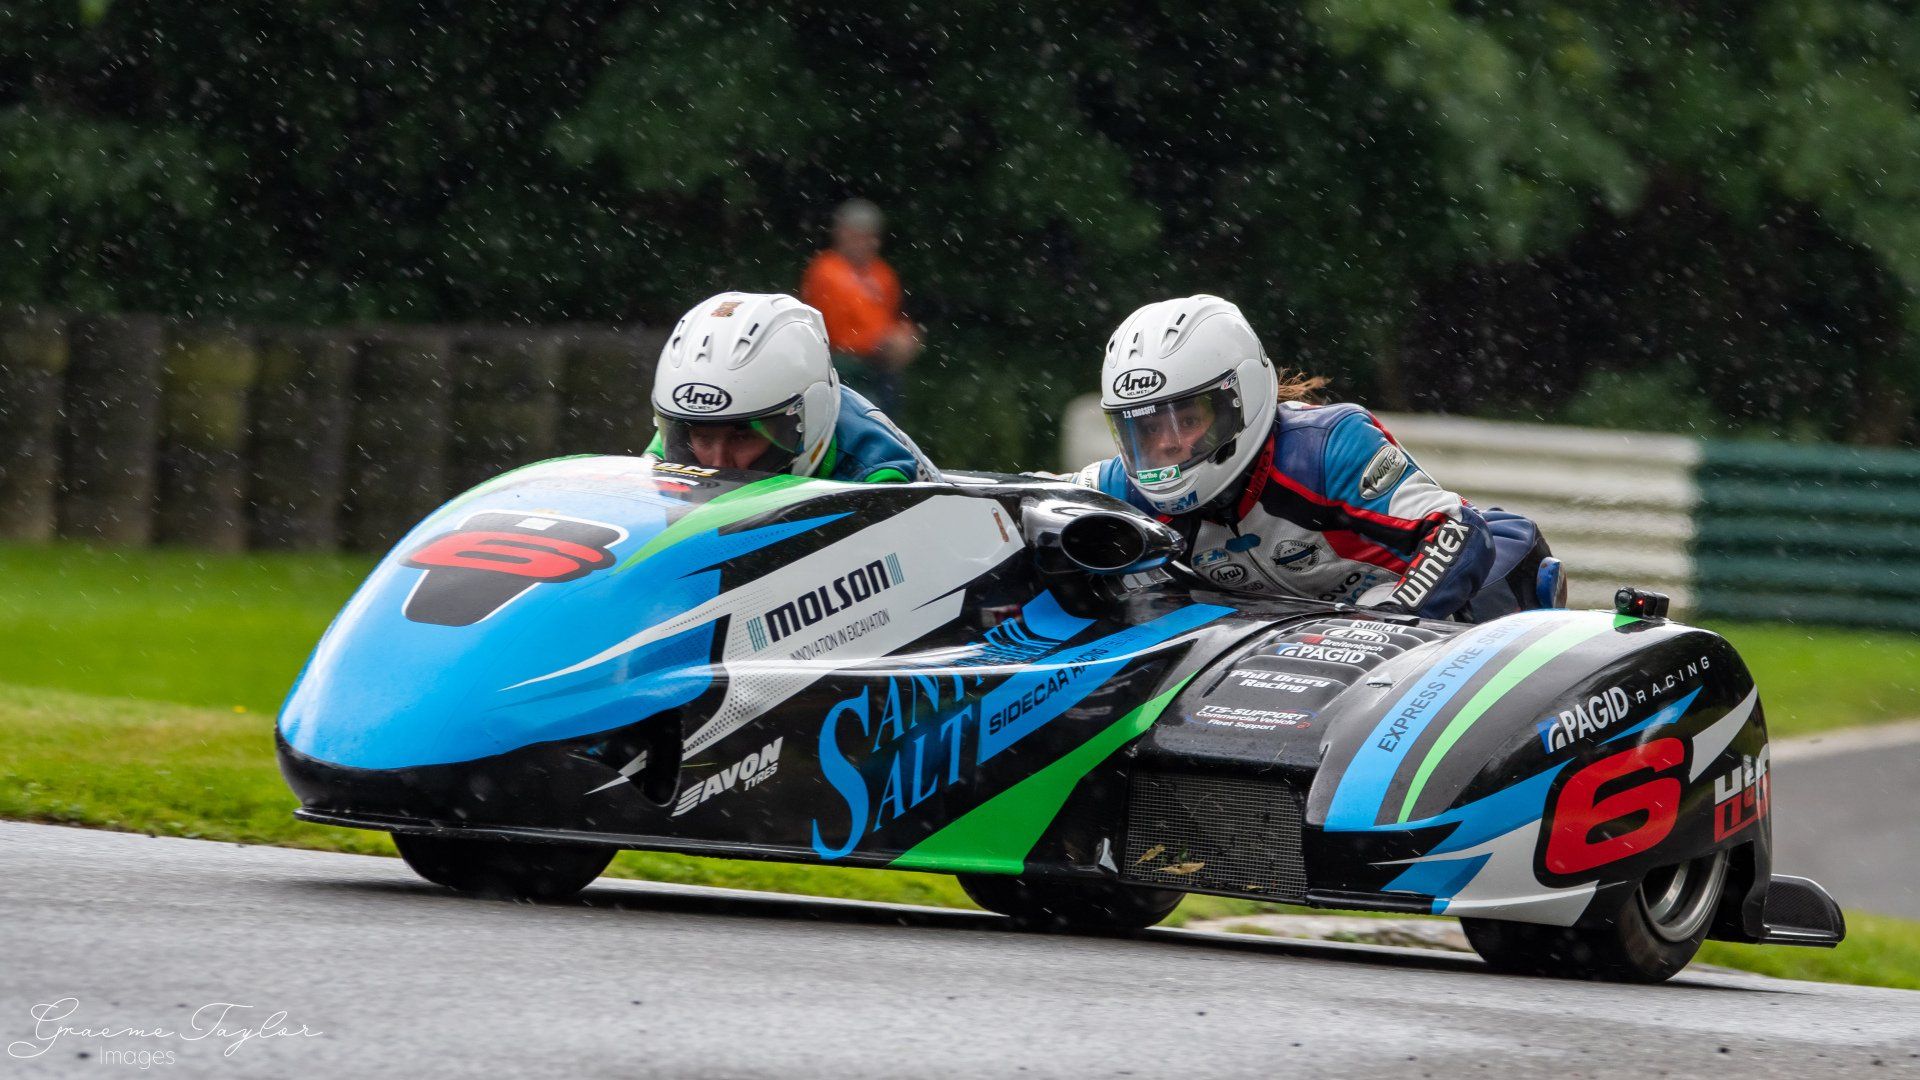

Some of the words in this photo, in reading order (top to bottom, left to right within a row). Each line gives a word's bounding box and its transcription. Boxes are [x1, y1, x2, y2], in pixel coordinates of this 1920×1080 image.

[1116, 371, 1159, 394] Arai
[675, 385, 723, 406] Arai
[409, 531, 604, 579] 6
[765, 559, 890, 642] MOLSON
[837, 628, 848, 645] IN
[847, 608, 891, 641] EXCAVATION
[1355, 620, 1400, 634] SHOCK
[1295, 645, 1366, 663] PAGID
[1320, 638, 1384, 652] Breitenbach
[1229, 670, 1271, 680] Phil
[1272, 674, 1331, 688] Drury
[1239, 679, 1309, 693] Racing
[990, 667, 1069, 736] SIDECAR
[1377, 681, 1447, 753] EXPRESS
[1438, 647, 1485, 679] TYRE
[1559, 686, 1630, 744] PAGID
[1636, 656, 1710, 704] RACING
[1196, 711, 1259, 722] Commercial
[1258, 716, 1297, 726] Vehicle
[1202, 704, 1309, 721] TTS-SUPPORT
[1207, 719, 1233, 727] Fleet
[1234, 721, 1277, 731] Support
[699, 736, 784, 803] AVON
[744, 762, 779, 792] TYRES
[1545, 737, 1685, 875] 6
